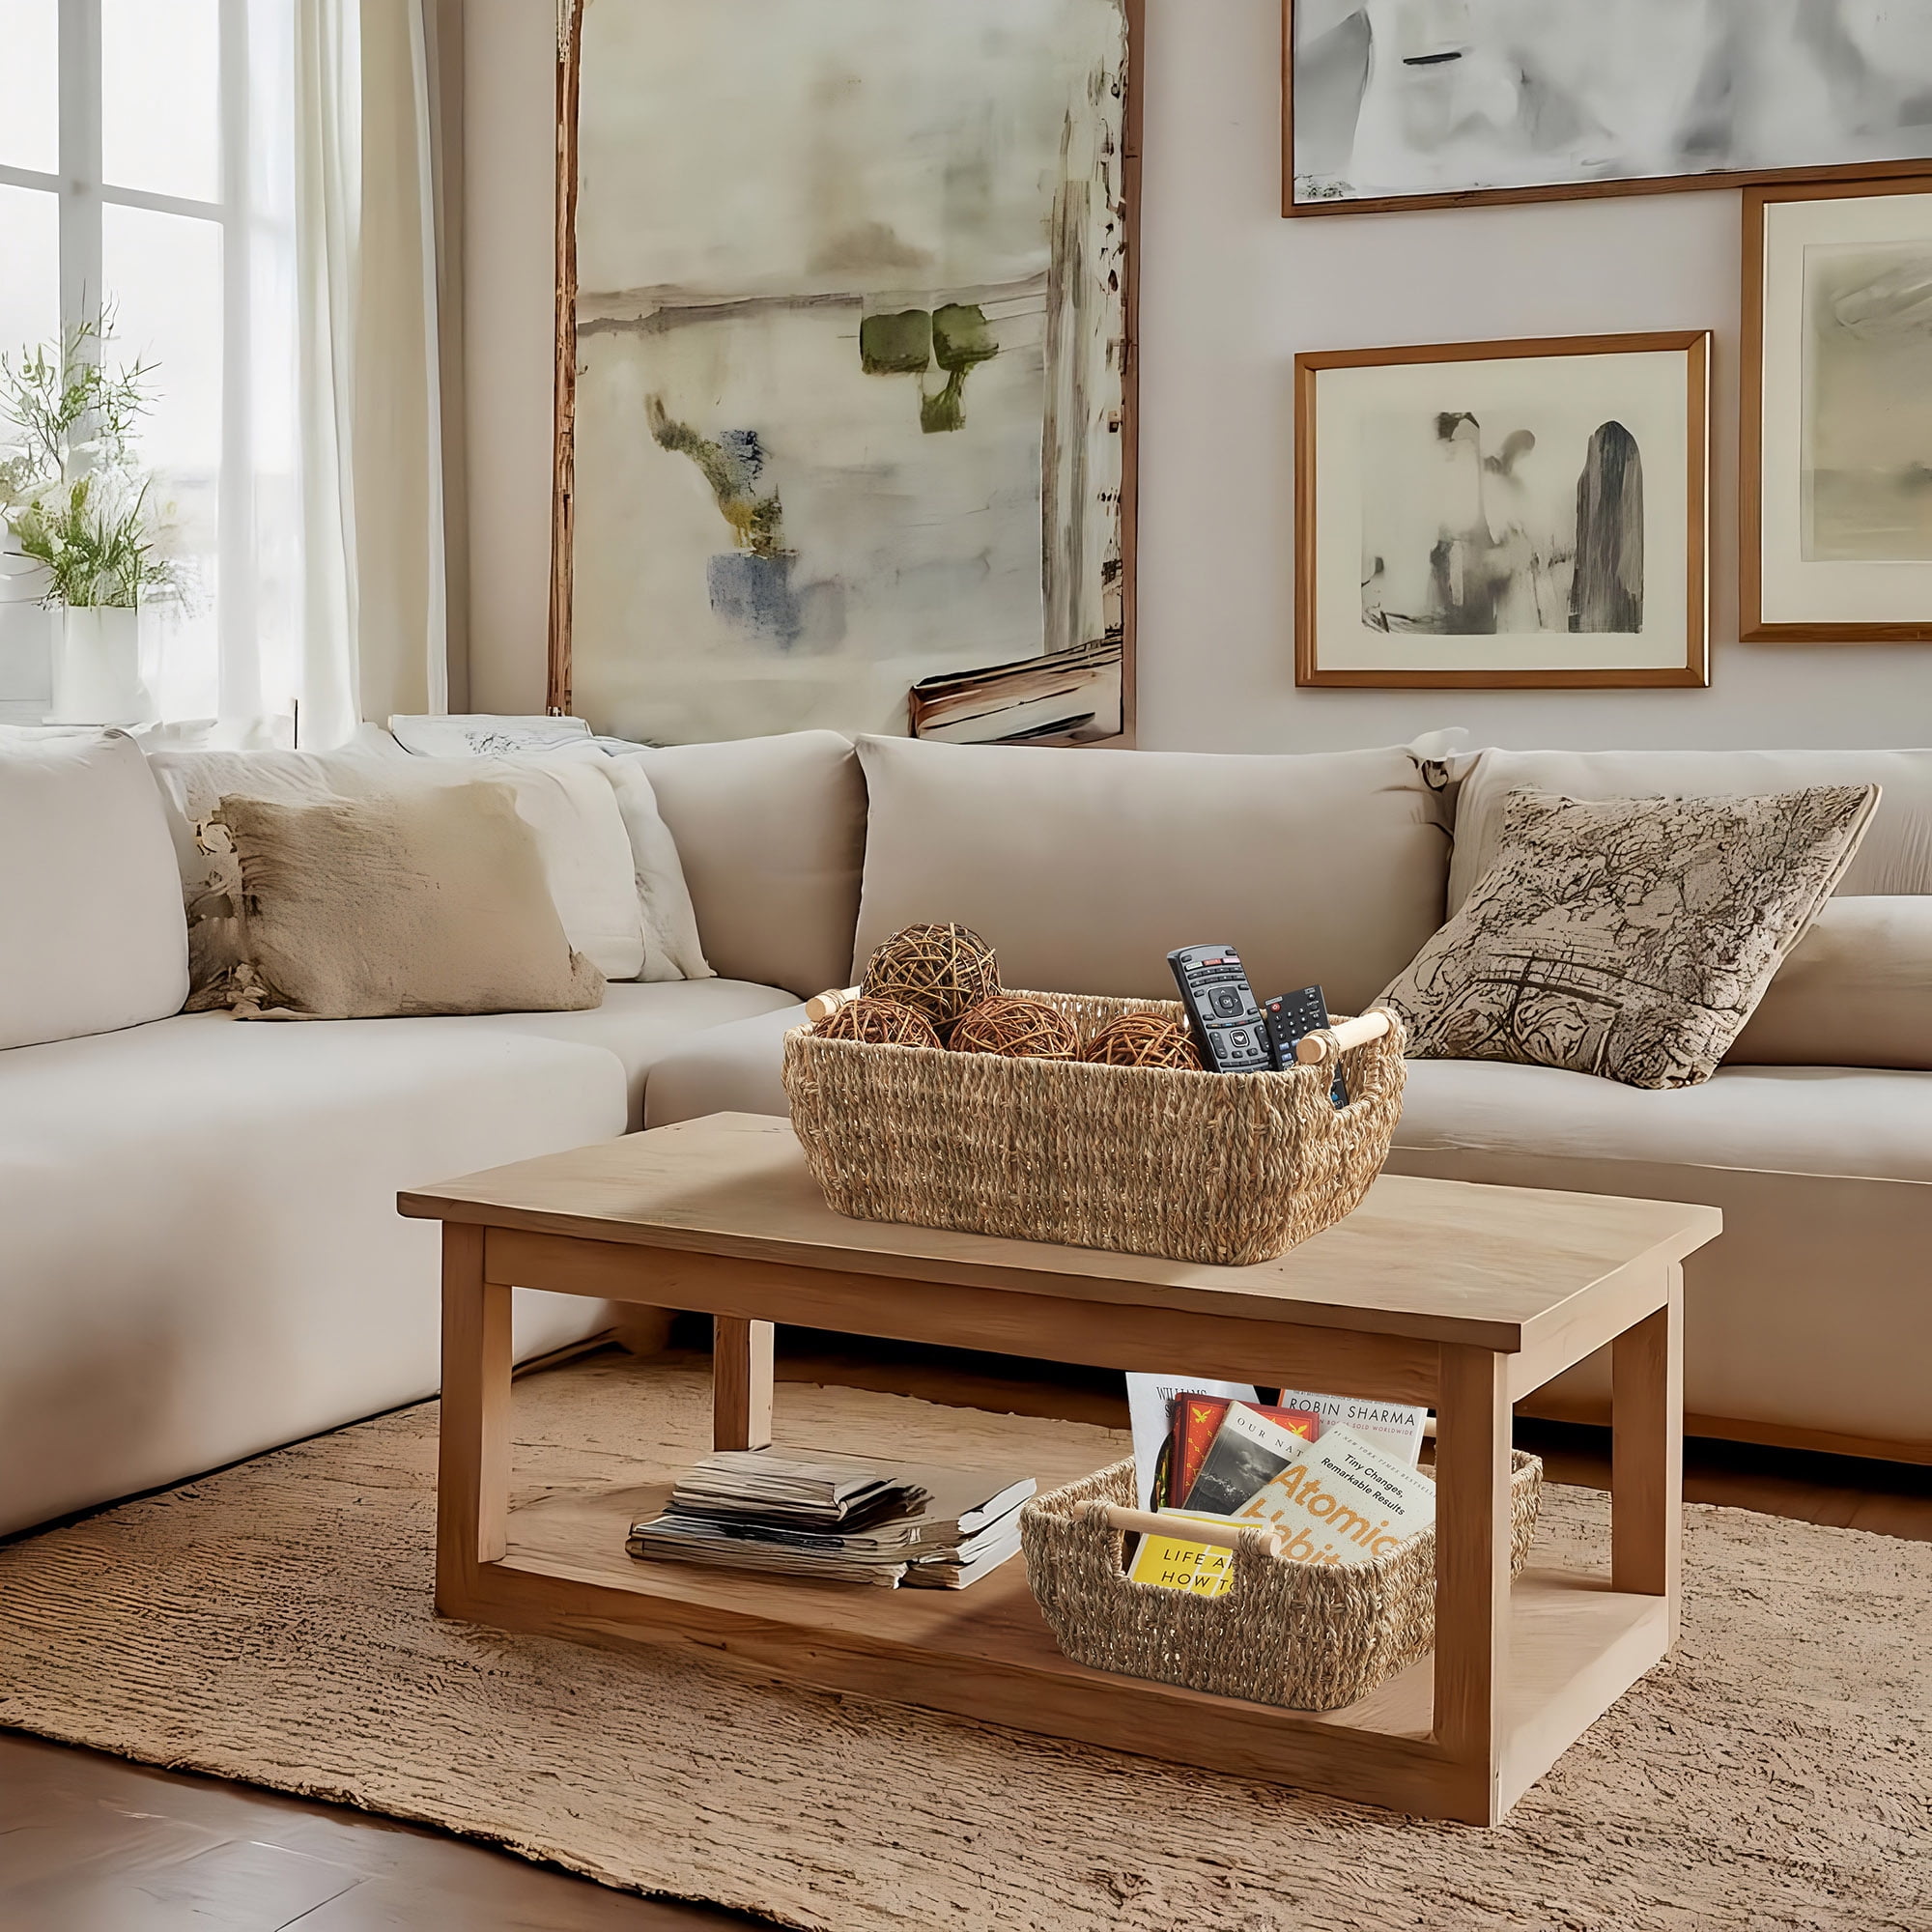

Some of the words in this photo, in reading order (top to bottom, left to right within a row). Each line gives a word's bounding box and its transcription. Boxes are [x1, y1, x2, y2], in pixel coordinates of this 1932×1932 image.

[1289, 1398, 1341, 1416] ROBIN
[1348, 1406, 1415, 1426] SHARMA
[1237, 1417, 1265, 1438] OUR
[1372, 1426, 1413, 1436] WORLDWIDE
[1321, 1457, 1373, 1494] Remarkable
[1372, 1491, 1406, 1516] Results
[1344, 1454, 1364, 1471] Tiny
[1364, 1467, 1404, 1498] Changes,
[1267, 1464, 1401, 1556] Atomic
[1163, 1548, 1206, 1565] LIFE
[1161, 1571, 1209, 1588] HOW
